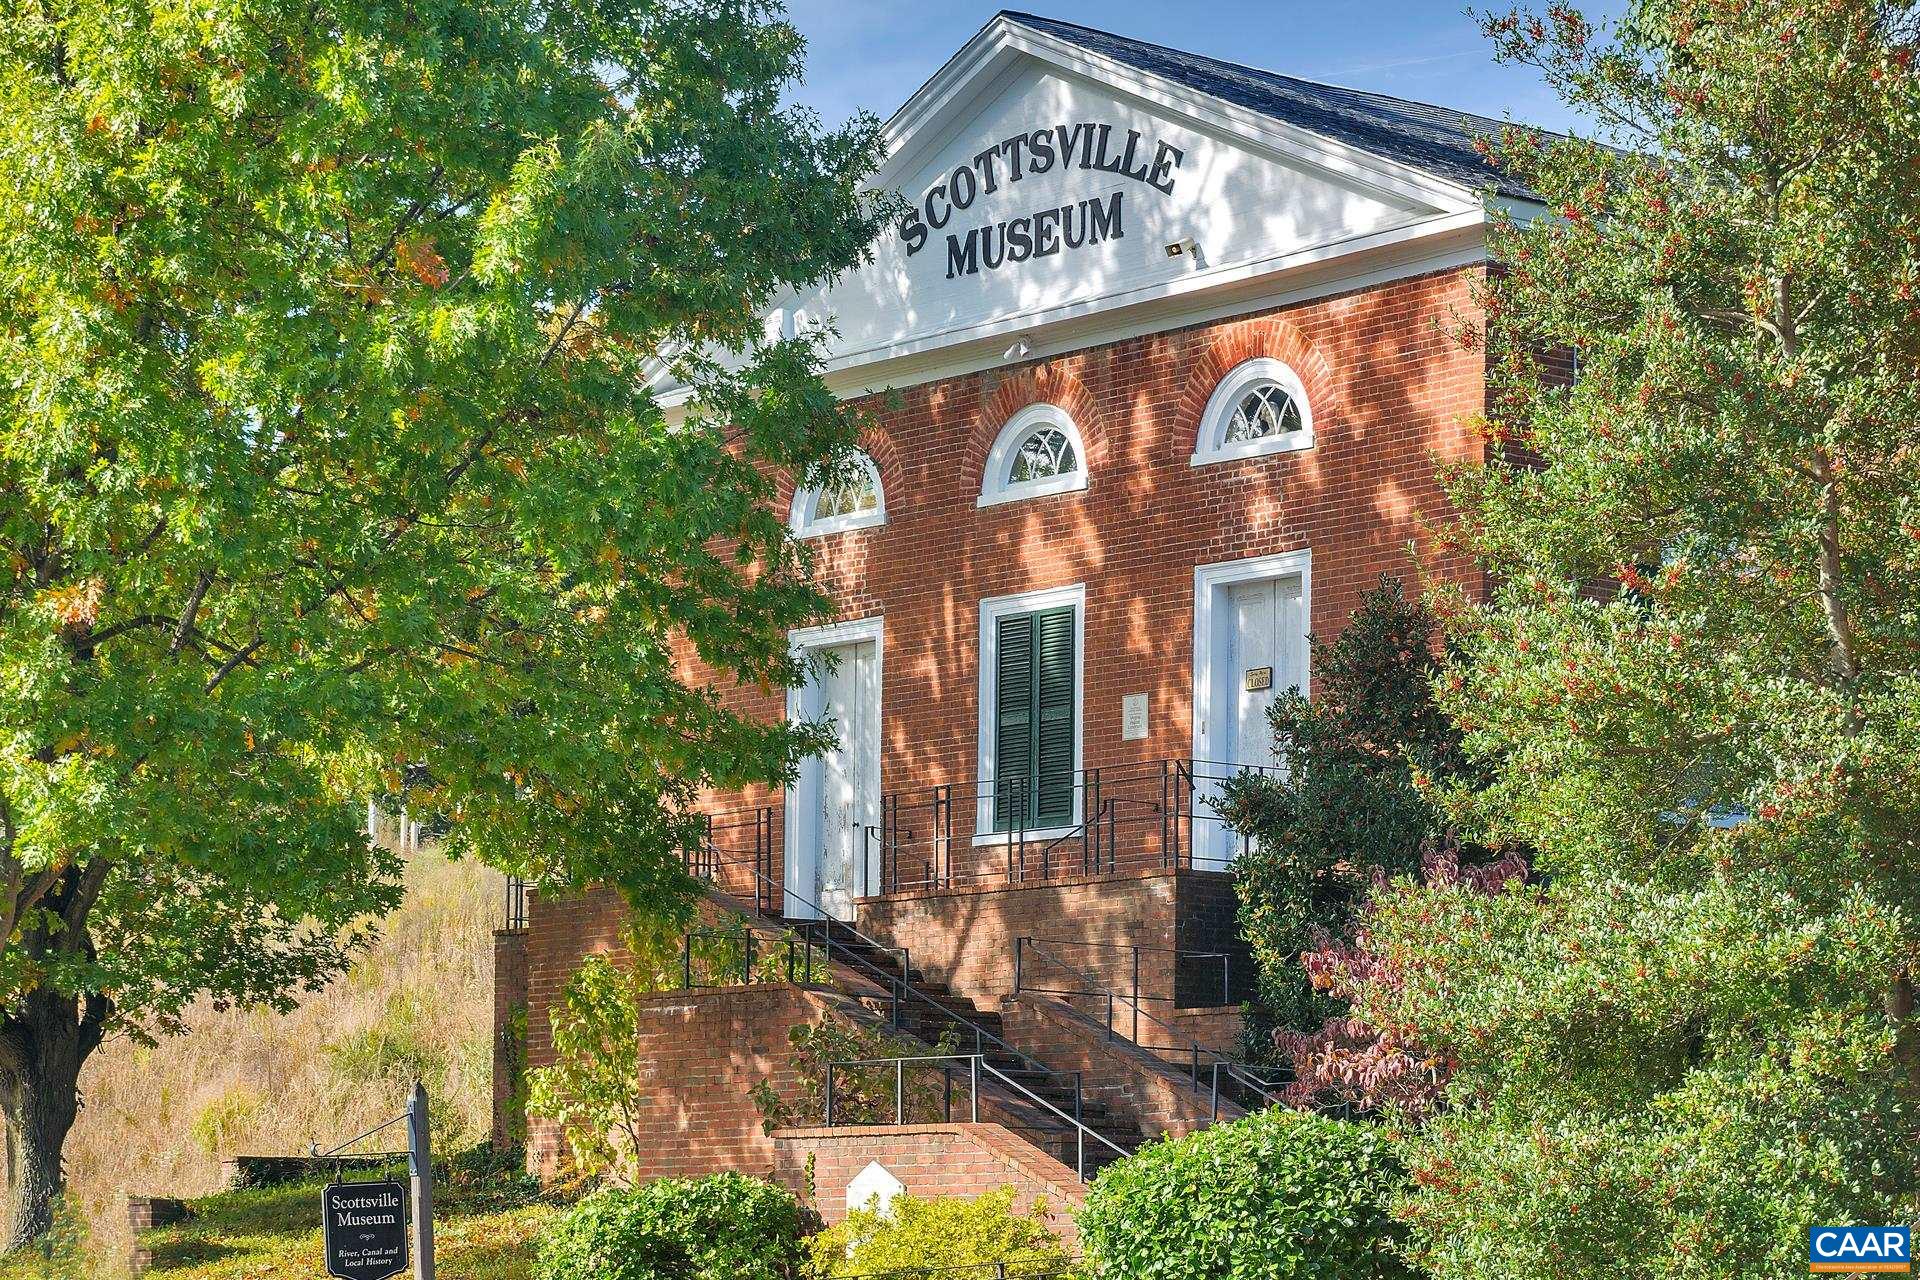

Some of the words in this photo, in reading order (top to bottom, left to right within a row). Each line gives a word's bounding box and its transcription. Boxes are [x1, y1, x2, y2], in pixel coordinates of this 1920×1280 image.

[899, 122, 1184, 257] SCOTTSVILLE
[945, 191, 1124, 280] MUSEUM
[332, 1193, 399, 1210] Scottsville
[337, 1211, 396, 1227] Museum
[338, 1249, 360, 1258] River,
[361, 1248, 383, 1256] Canal
[384, 1246, 399, 1255] and
[344, 1258, 364, 1267] Local
[365, 1257, 393, 1266] History
